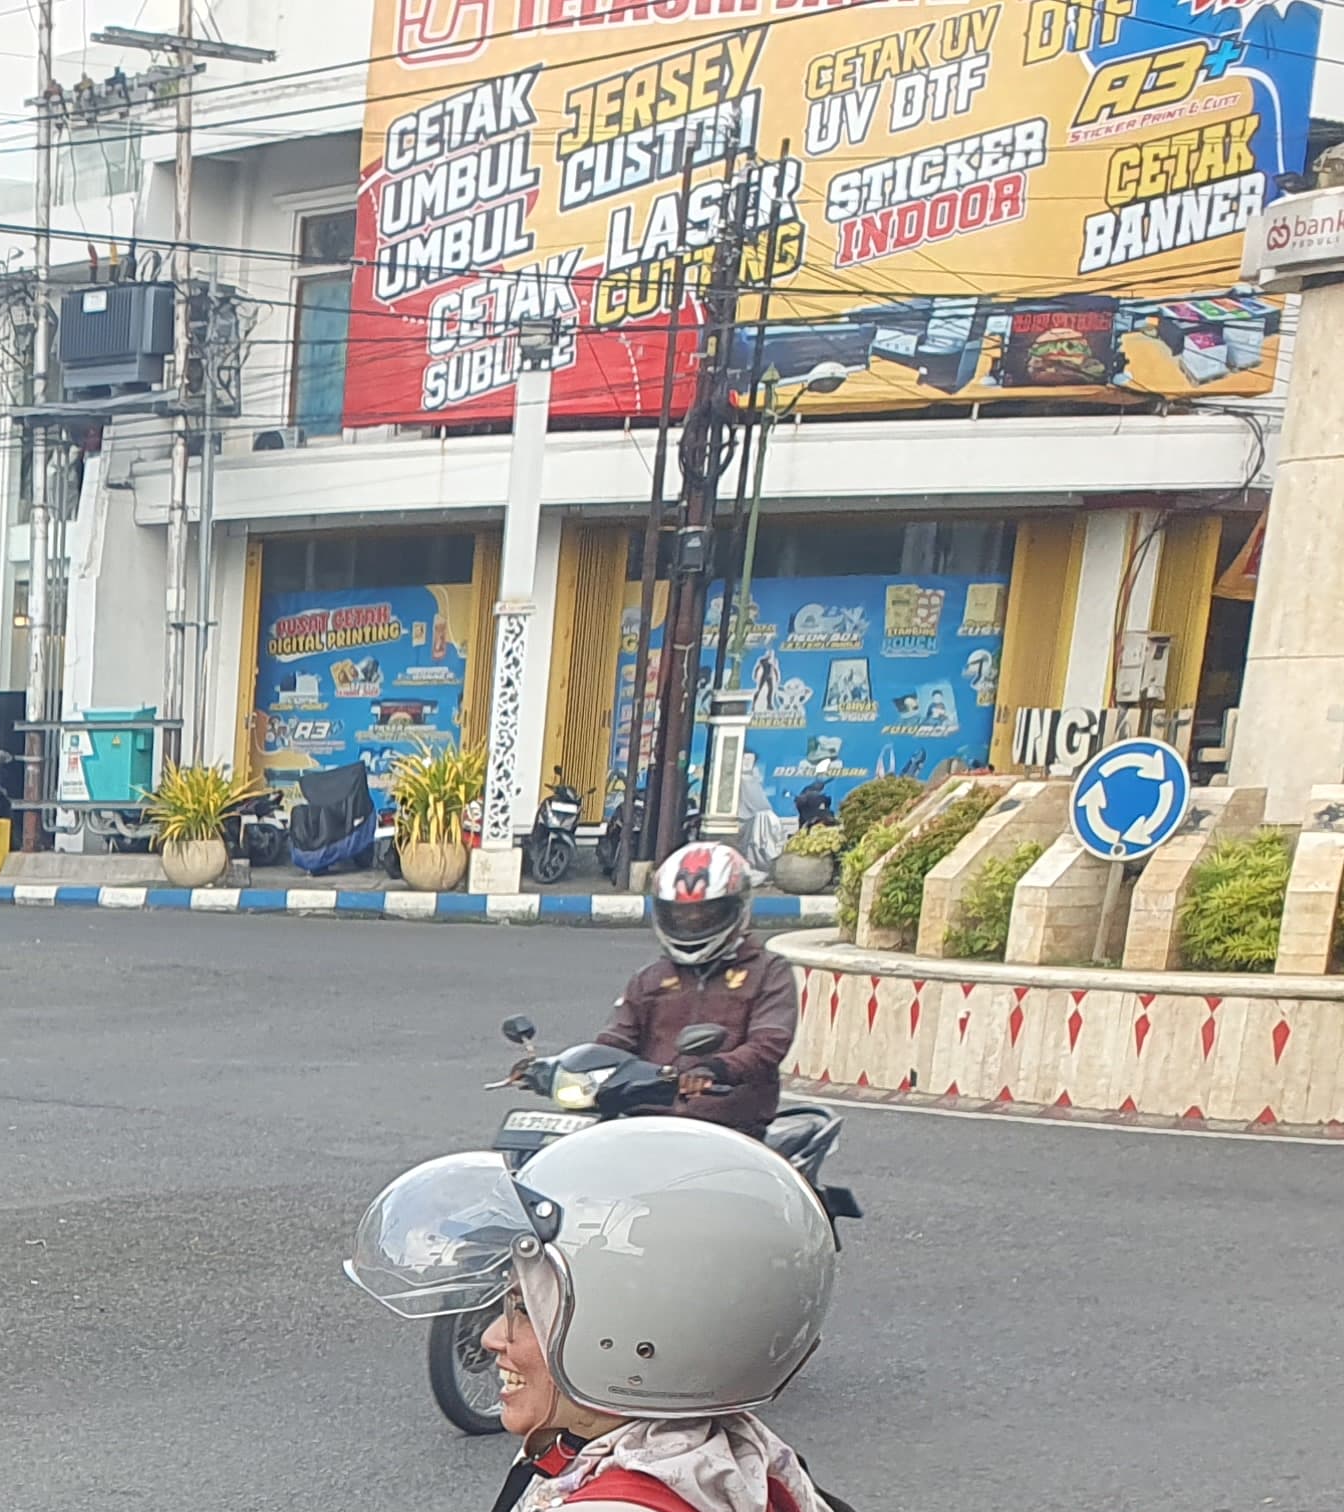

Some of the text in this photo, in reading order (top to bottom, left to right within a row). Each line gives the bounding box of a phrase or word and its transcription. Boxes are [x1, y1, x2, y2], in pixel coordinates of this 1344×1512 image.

[557, 24, 771, 161] JERSEY
[805, 5, 1001, 101] CETAK UV
[806, 53, 990, 156] UV DTF
[384, 64, 544, 175] CETAK
[559, 88, 763, 212] CUSTOM
[826, 117, 1048, 223] STICKER
[1069, 117, 1138, 144] STICKER
[1140, 109, 1183, 127] PRINT
[1106, 114, 1260, 208] CETAK
[380, 131, 540, 237] UMBUL
[835, 172, 1026, 267] INDOOR
[1078, 172, 1266, 275] BANNER
[375, 199, 535, 301] UMBUL
[595, 221, 806, 327] CUTTNG
[427, 247, 584, 357] CETAK
[423, 316, 576, 409] SUBLE
[268, 621, 402, 656] DIGITAL PRINTING
